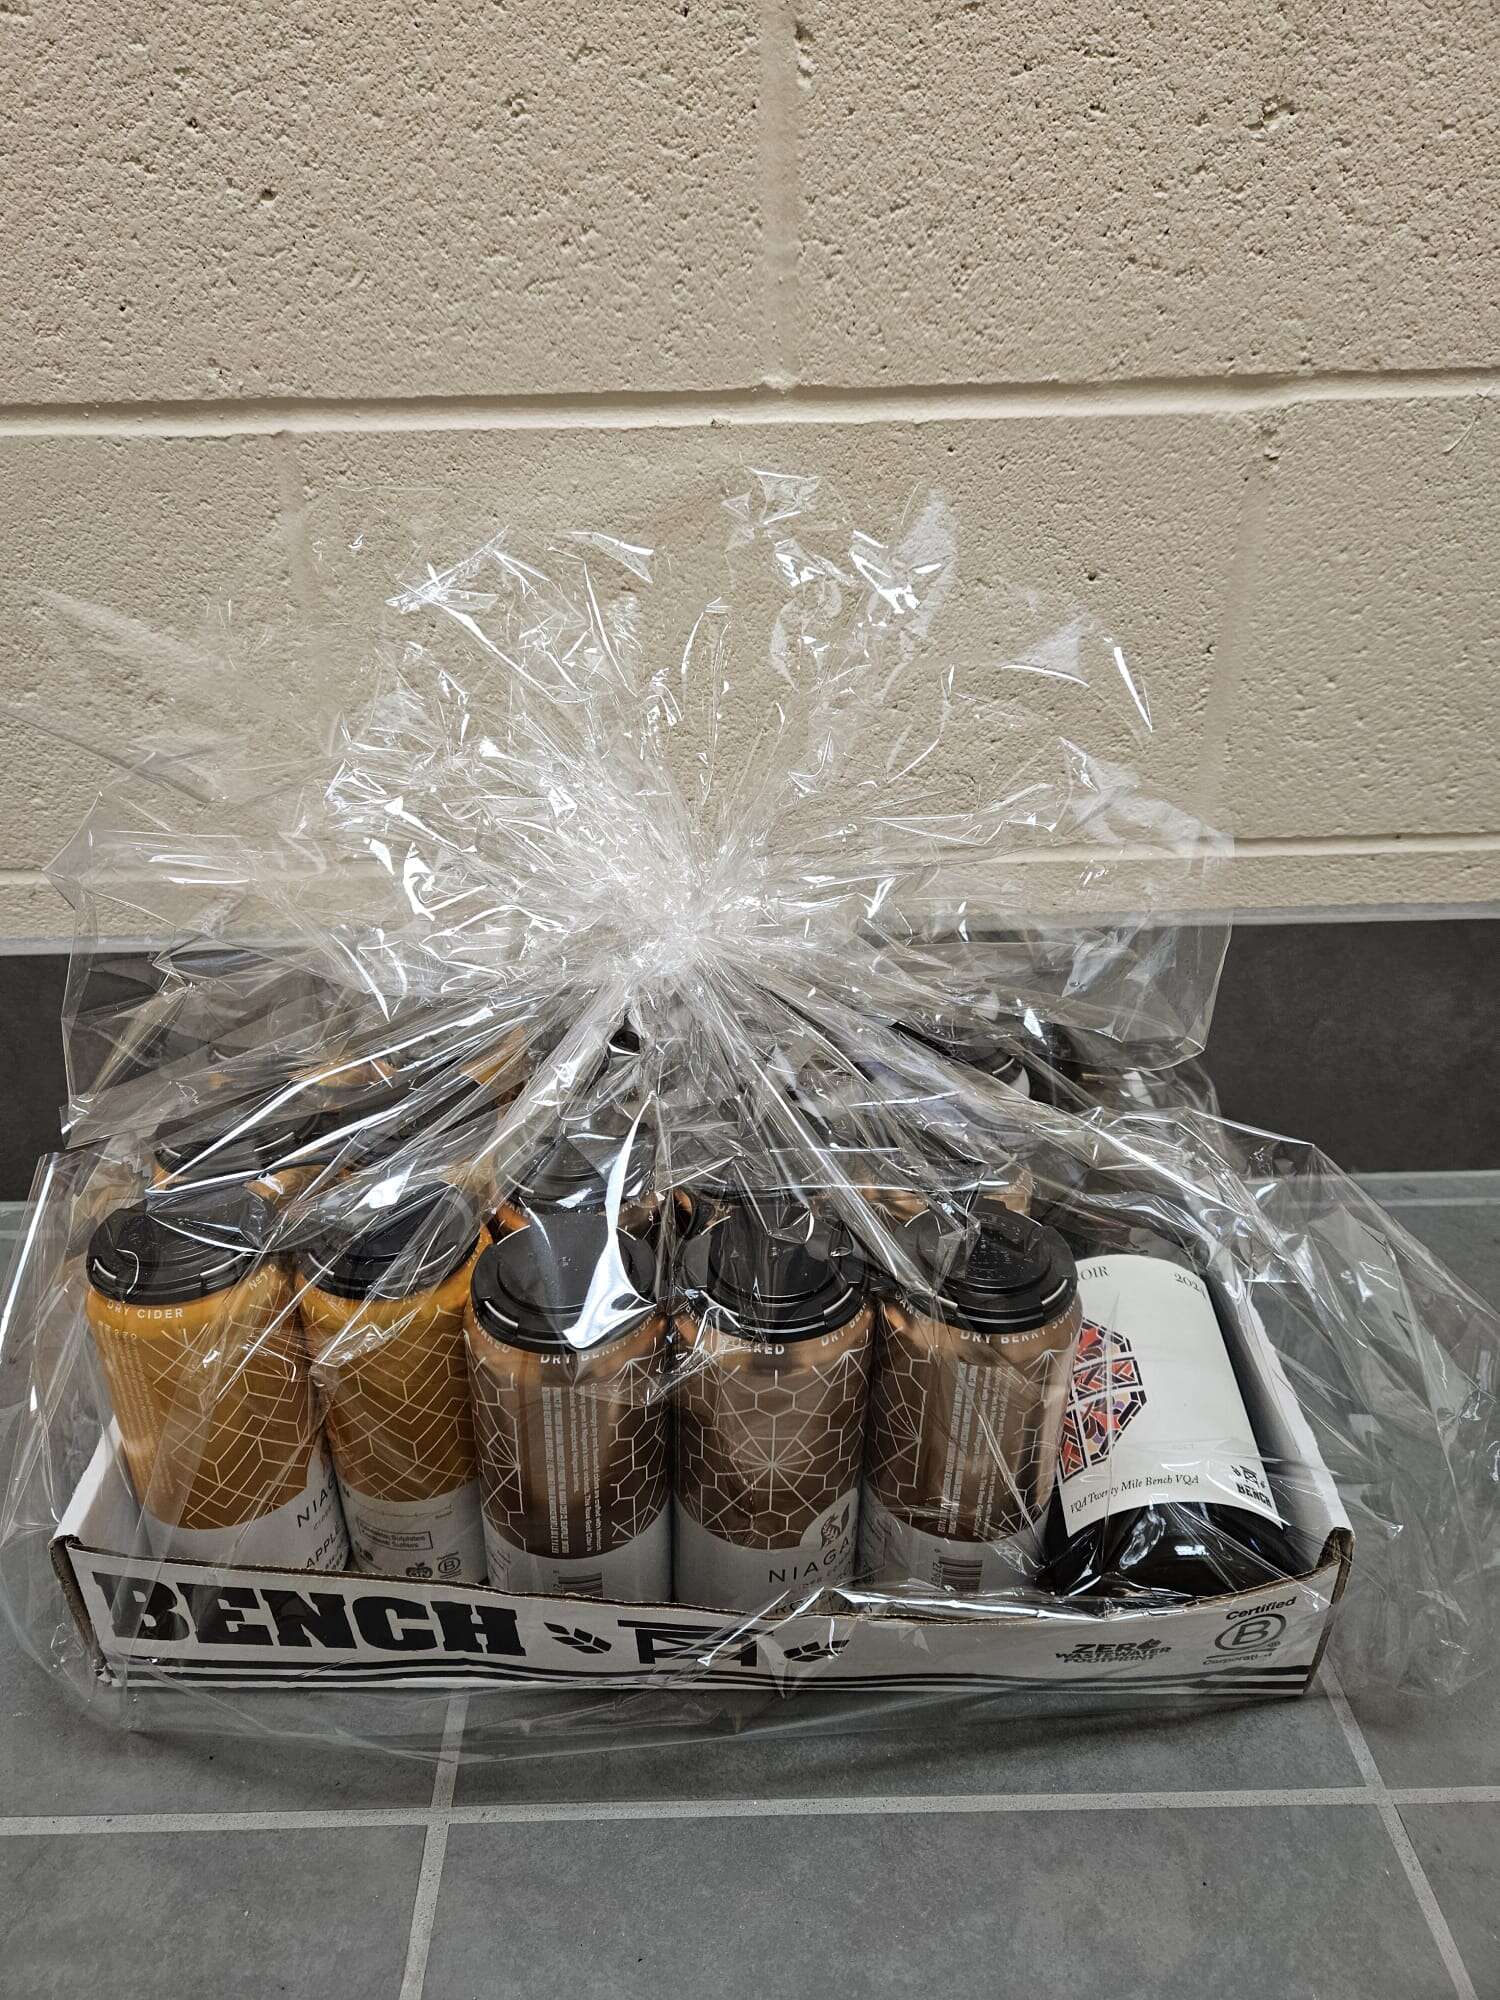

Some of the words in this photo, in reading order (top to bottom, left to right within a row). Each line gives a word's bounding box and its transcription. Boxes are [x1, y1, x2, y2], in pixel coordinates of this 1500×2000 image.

[1076, 1265, 1109, 1281] OIR
[137, 1303, 183, 1320] CIDER
[1070, 1499, 1086, 1514] VQA
[1121, 1478, 1142, 1492] Mile
[1146, 1476, 1173, 1487] Bench
[1176, 1474, 1200, 1486] VQA
[92, 1571, 527, 1657] BENCH
[1226, 1596, 1298, 1620] Certified
